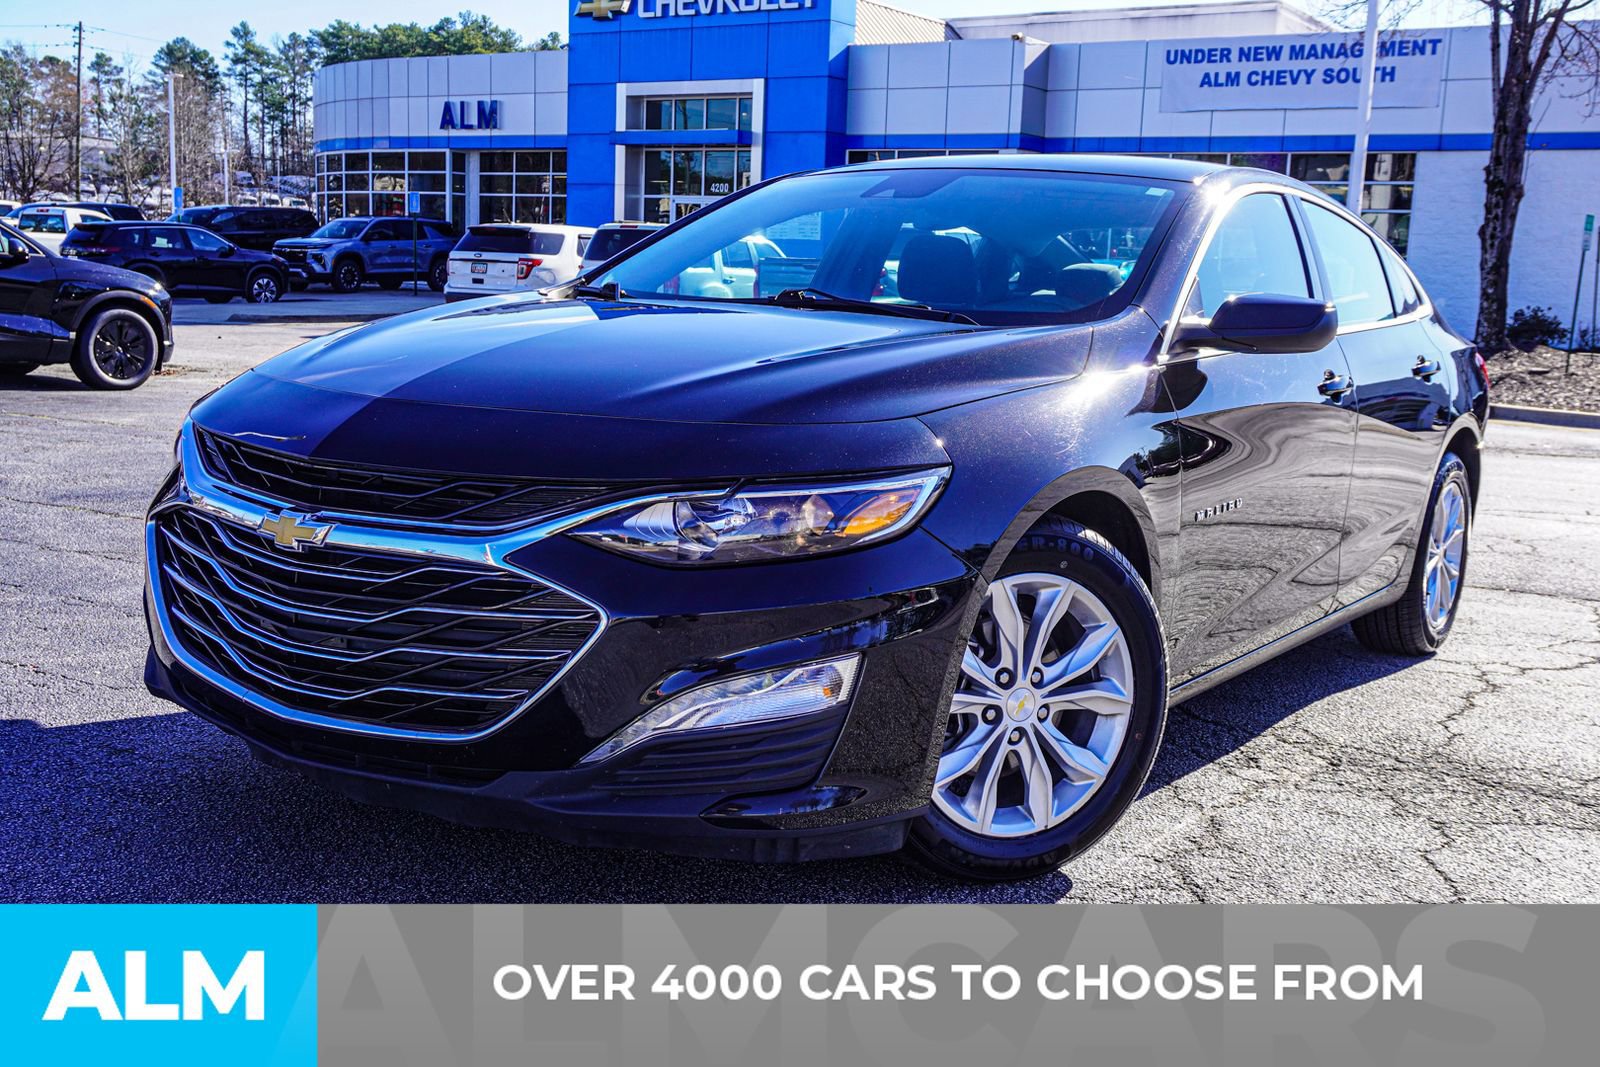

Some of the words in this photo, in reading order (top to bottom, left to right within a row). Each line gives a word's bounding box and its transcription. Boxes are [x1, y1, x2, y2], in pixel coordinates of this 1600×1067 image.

[1165, 47, 1232, 65] UNDER
[1238, 44, 1284, 63] NEW
[1288, 38, 1443, 60] MANAGMENT
[1199, 70, 1241, 88] ALM
[1246, 68, 1317, 86] CHEVY
[439, 99, 500, 130] ALM
[710, 182, 729, 193] 4200
